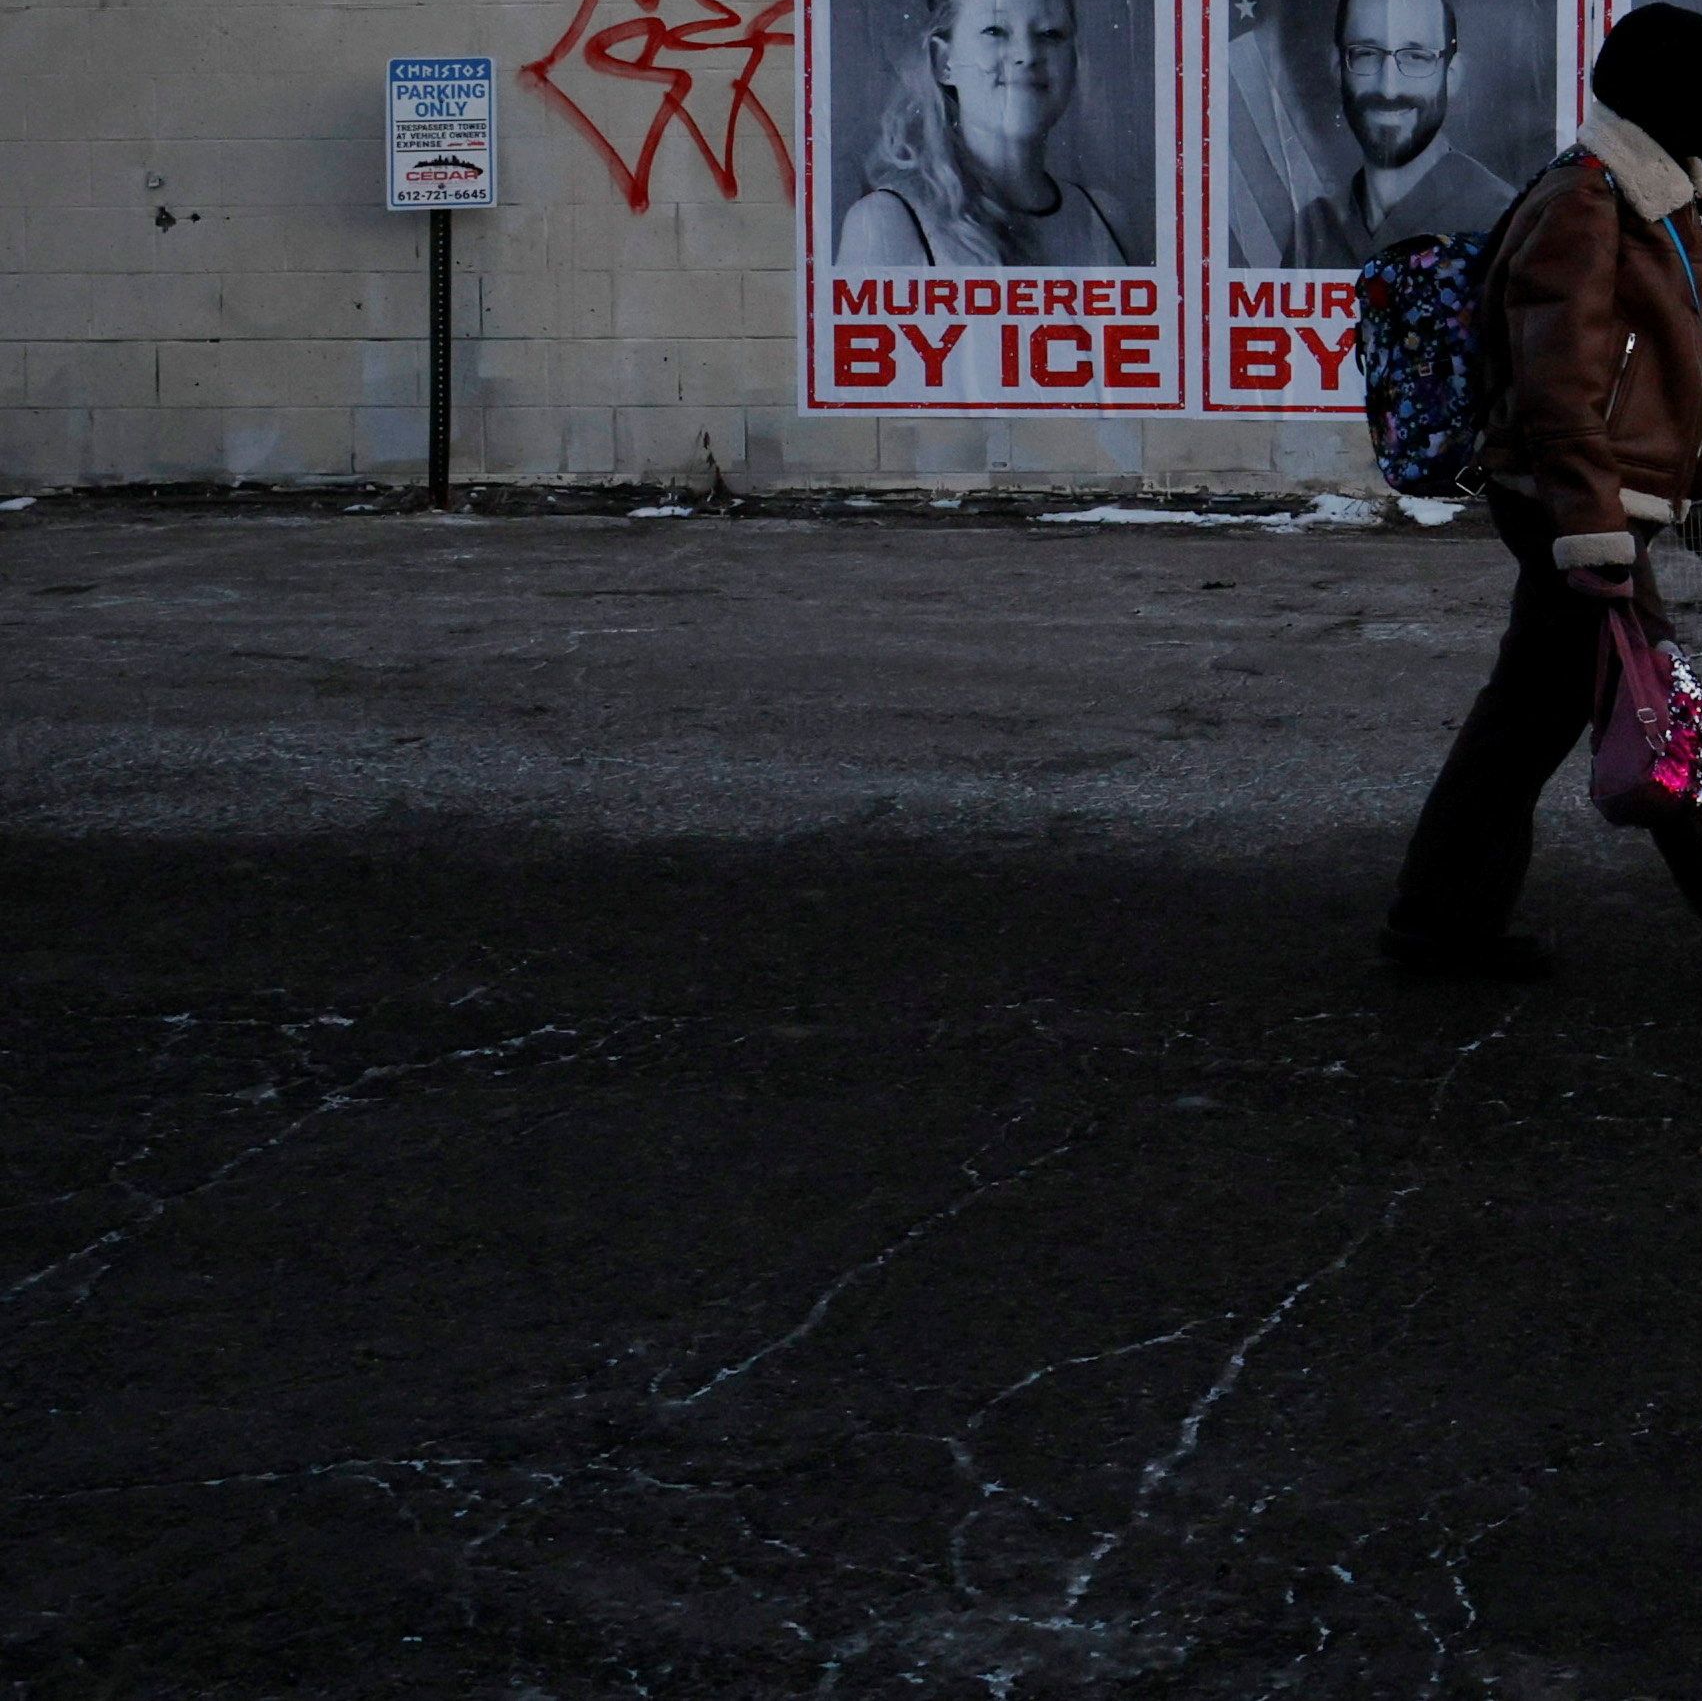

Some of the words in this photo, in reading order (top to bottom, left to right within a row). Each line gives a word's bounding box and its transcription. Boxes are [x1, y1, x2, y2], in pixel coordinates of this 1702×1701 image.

[396, 64, 485, 78] CHRISTOS
[397, 84, 485, 99] PARKING
[416, 102, 467, 117] ONLY
[407, 171, 477, 181] CEDAR
[834, 280, 1156, 315] MURDERED
[835, 325, 965, 386] BY
[1002, 325, 1160, 387] ICE
[1231, 327, 1355, 389] BY
